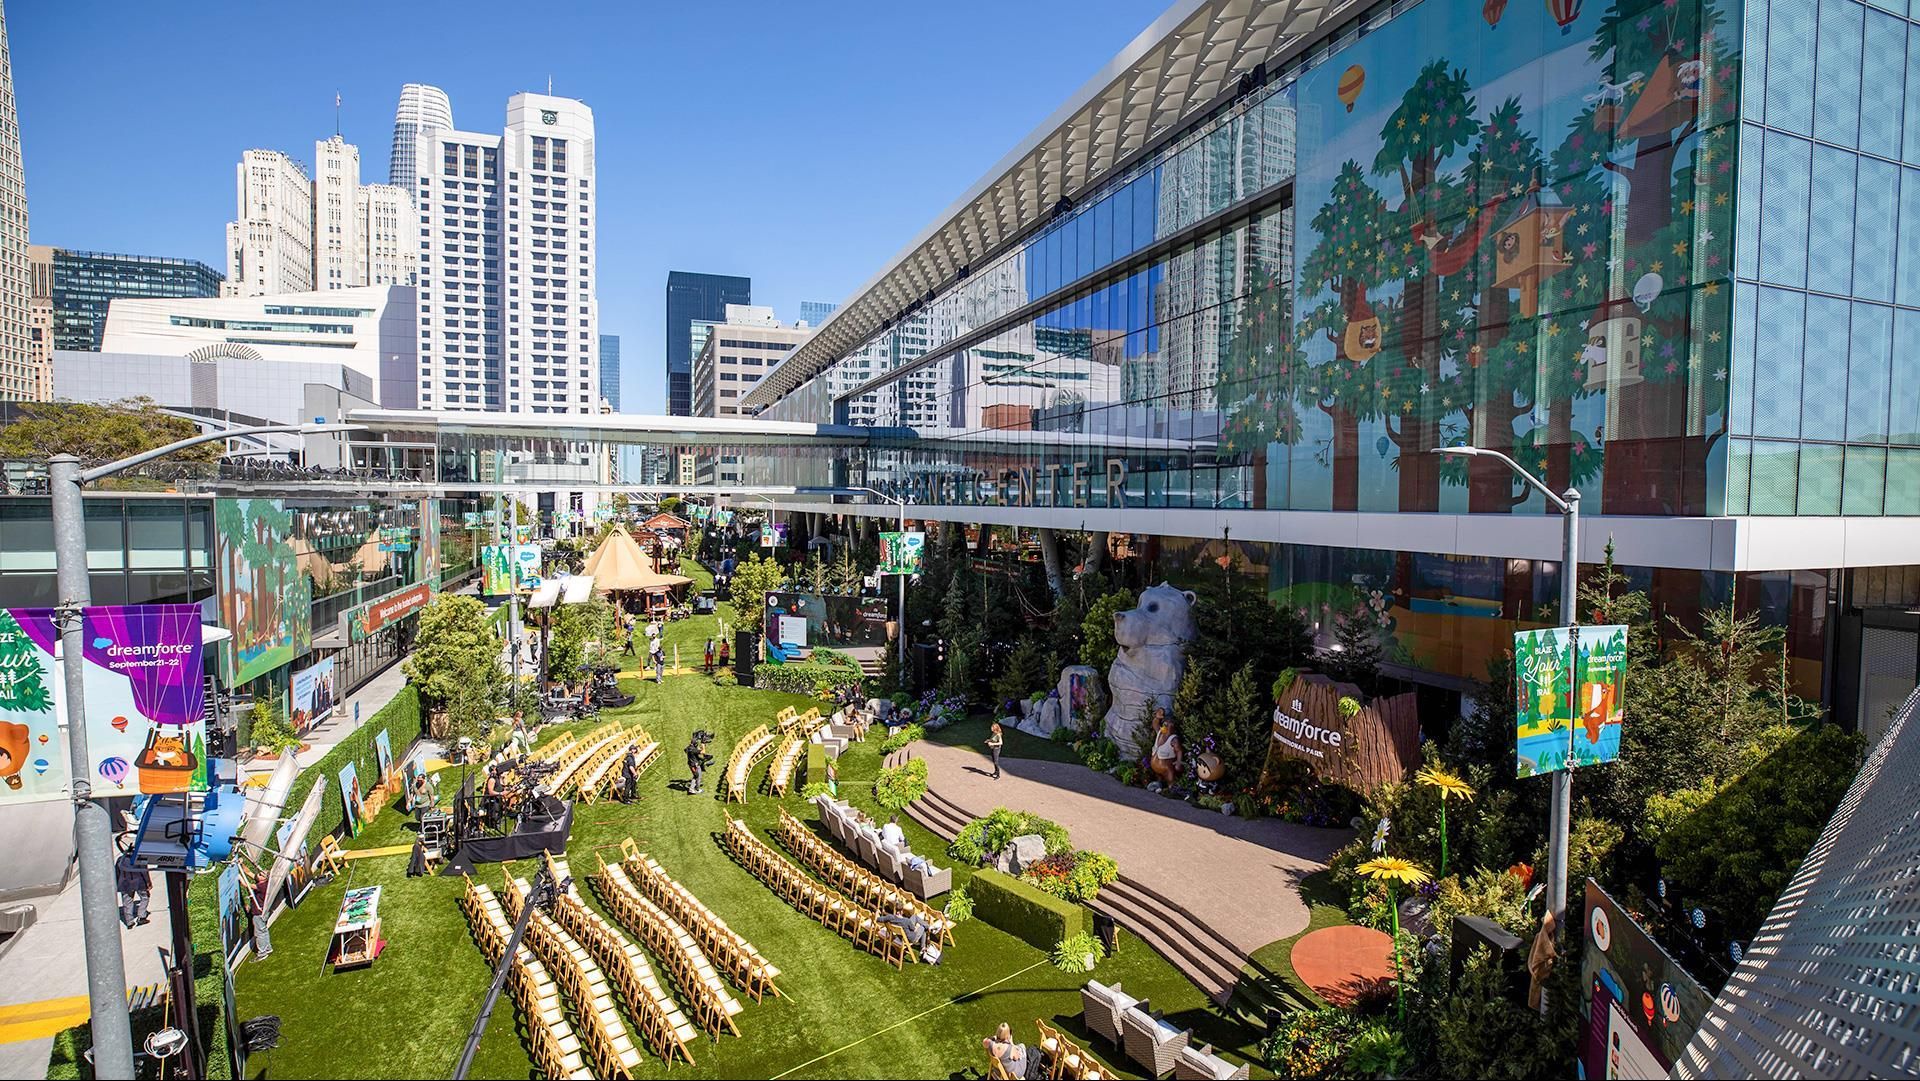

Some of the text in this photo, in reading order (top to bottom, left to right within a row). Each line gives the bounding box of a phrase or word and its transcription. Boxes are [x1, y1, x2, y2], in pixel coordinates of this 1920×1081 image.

[974, 458, 1126, 508] CENTER
[107, 643, 193, 657] dreamforce
[1535, 646, 1552, 655] BLAZE
[0, 650, 33, 668] ur
[1588, 654, 1623, 665] dreamforce
[1523, 655, 1561, 683] Your
[0, 689, 17, 700] AIL
[1273, 705, 1341, 747] dreamforce
[1306, 747, 1324, 758] PARK
